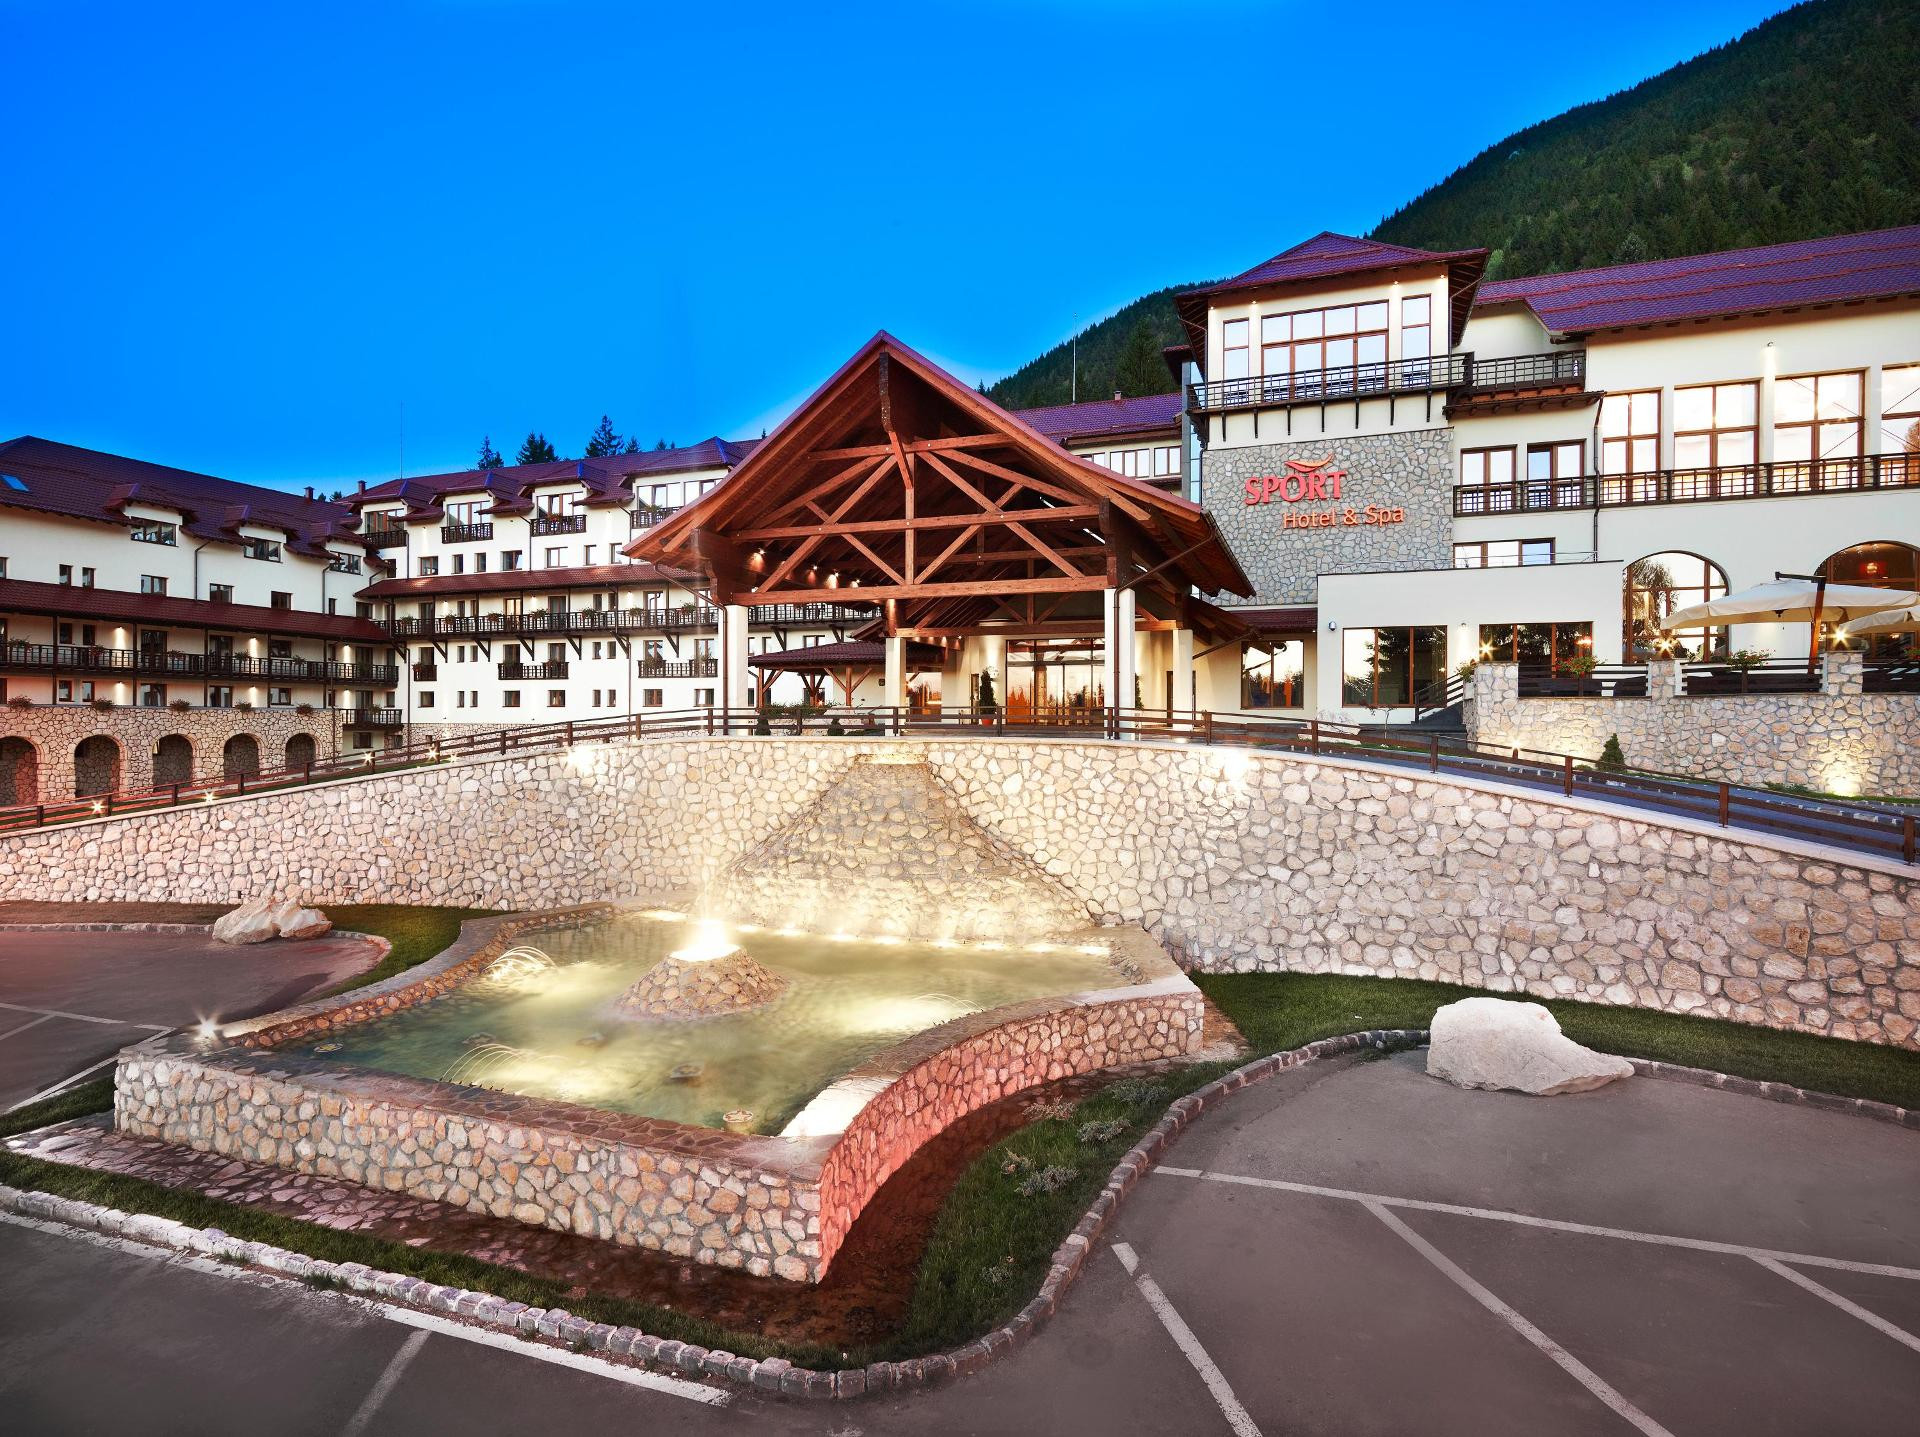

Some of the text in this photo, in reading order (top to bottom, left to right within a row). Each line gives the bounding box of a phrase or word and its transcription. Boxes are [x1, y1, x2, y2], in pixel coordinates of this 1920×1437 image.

[1244, 470, 1347, 505] SPORT
[1283, 503, 1404, 529] Hotel & Spa
